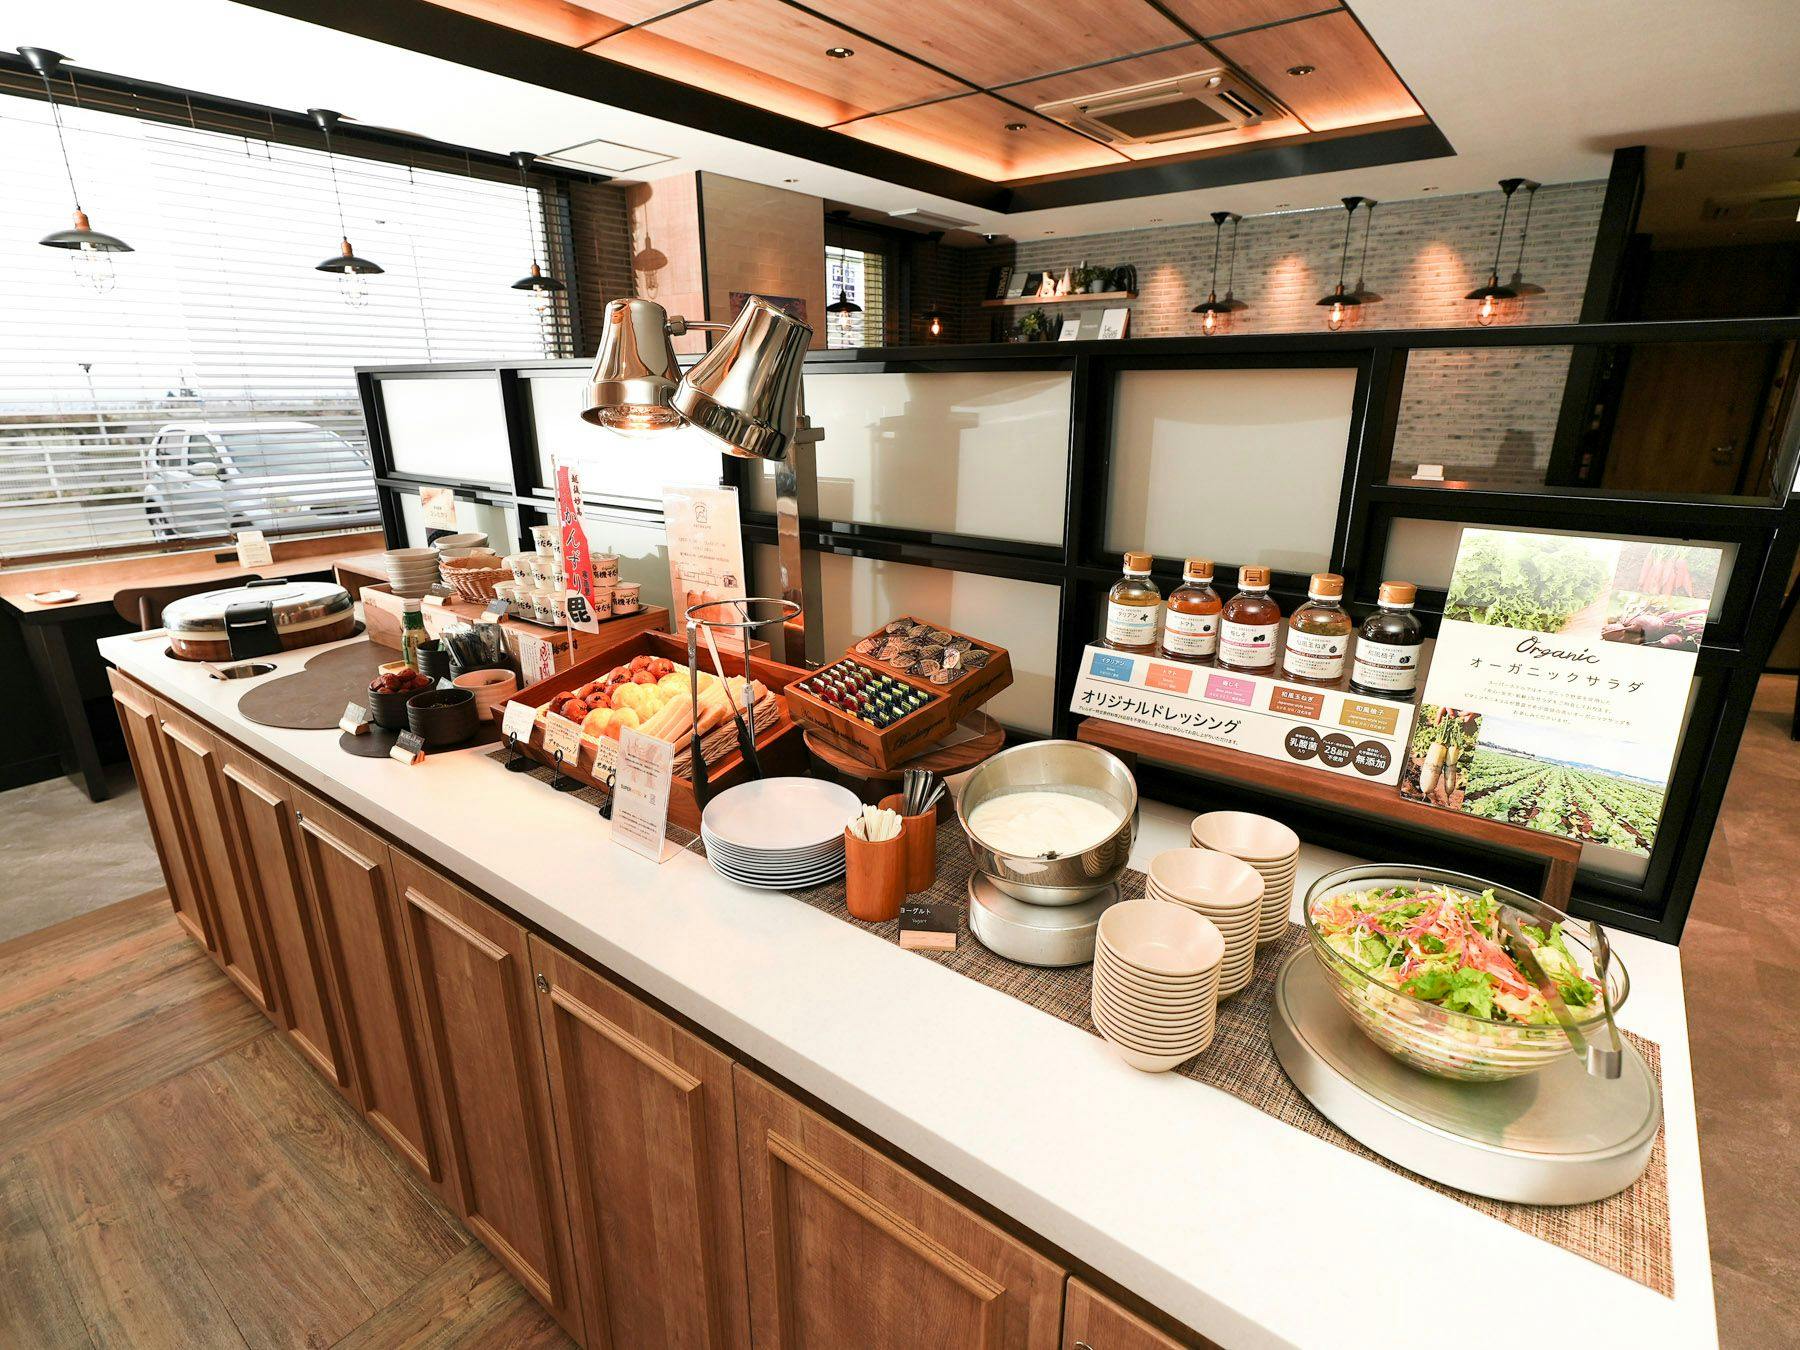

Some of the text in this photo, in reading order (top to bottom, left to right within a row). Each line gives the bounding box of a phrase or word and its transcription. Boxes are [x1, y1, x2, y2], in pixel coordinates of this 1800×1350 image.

[565, 507, 581, 596] かんずり
[567, 596, 592, 623] 毘
[1515, 635, 1601, 665] Organic
[1470, 656, 1646, 693] オーガニックサラダ
[1281, 691, 1314, 702] 和風玉ねぎ
[1081, 689, 1242, 735] オリジナルドレッシング
[1289, 737, 1318, 752] 乳酸菌
[1324, 745, 1350, 758] 28品目
[1327, 755, 1344, 763] 不使用
[1355, 755, 1387, 769] 無添加
[900, 907, 932, 915] ヨーグルト
